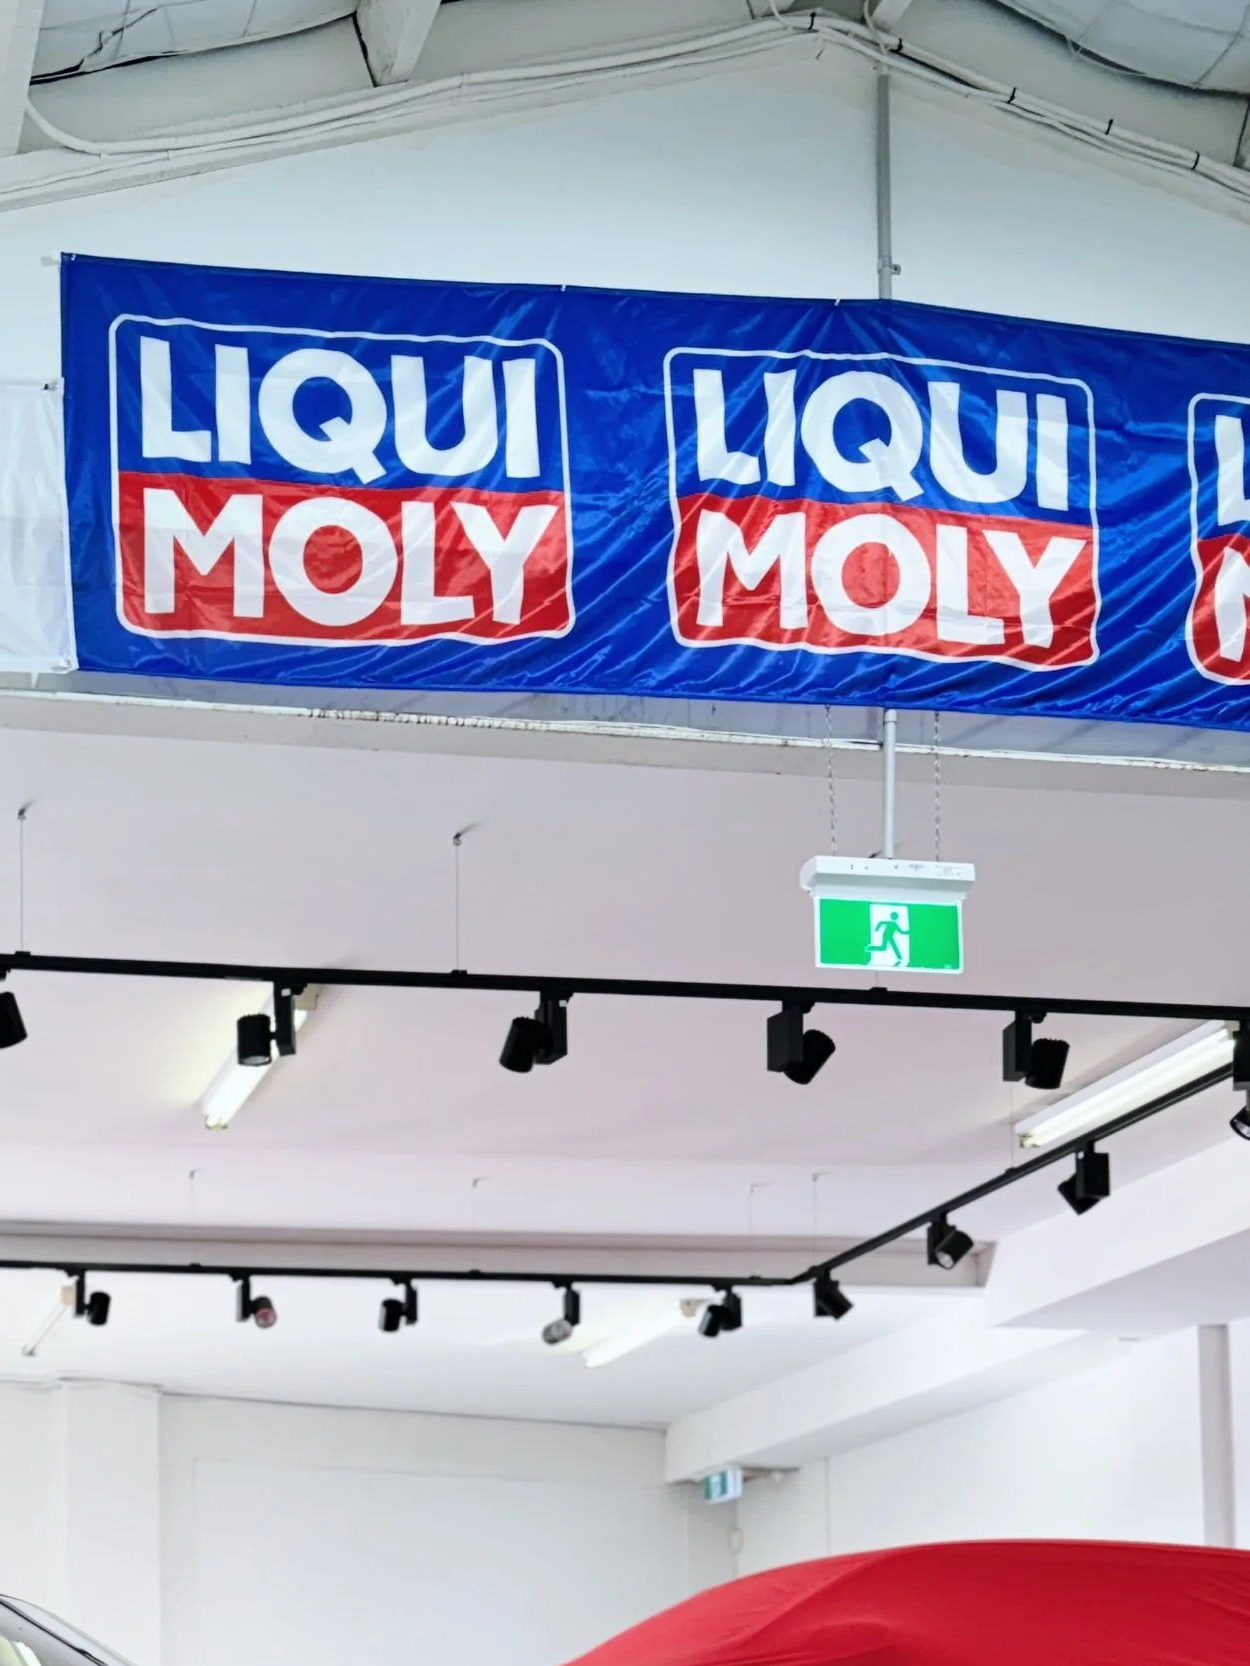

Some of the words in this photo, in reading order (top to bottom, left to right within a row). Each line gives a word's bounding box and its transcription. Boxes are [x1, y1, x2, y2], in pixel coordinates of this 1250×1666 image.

[140, 336, 540, 484] LIQUI
[693, 369, 1068, 511] LIQUI
[143, 488, 557, 626] MOLY
[695, 509, 1087, 648] MOLY
